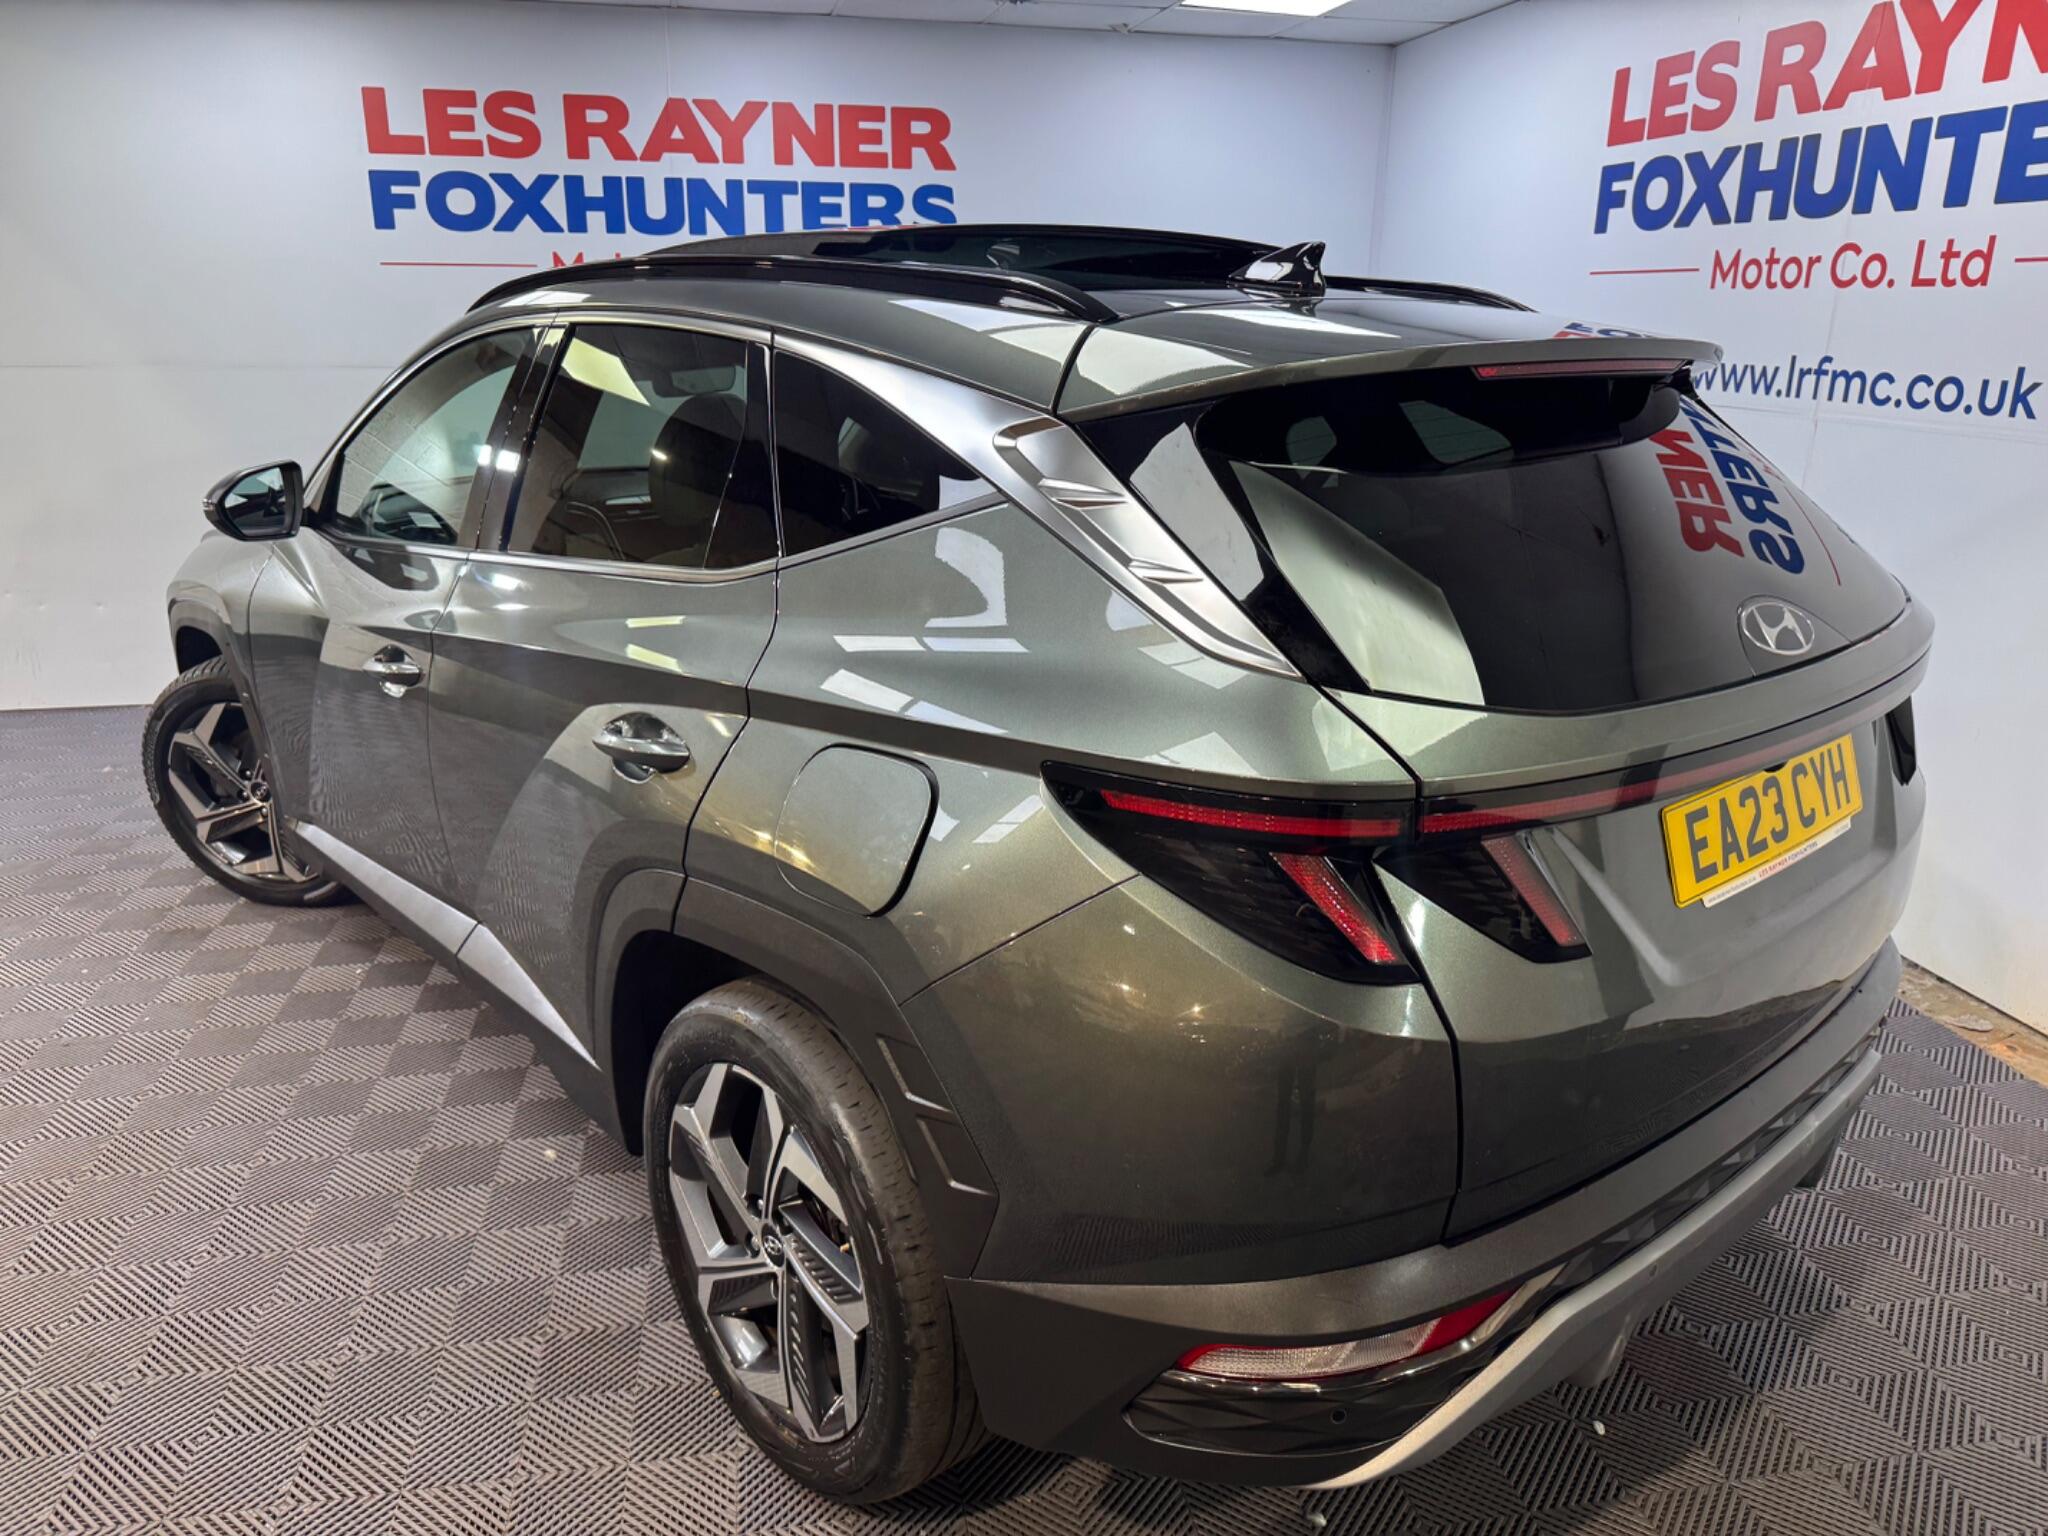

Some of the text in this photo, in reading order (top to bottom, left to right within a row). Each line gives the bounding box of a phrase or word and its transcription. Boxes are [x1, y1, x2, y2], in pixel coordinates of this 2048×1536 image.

[361, 86, 957, 171] LES RAYNER
[1606, 40, 1741, 148] LES
[368, 169, 957, 236] FOXHUNTERS
[1709, 235, 1997, 290] Motor Co. Ltd
[1685, 743, 1851, 884] EA23 CYH
